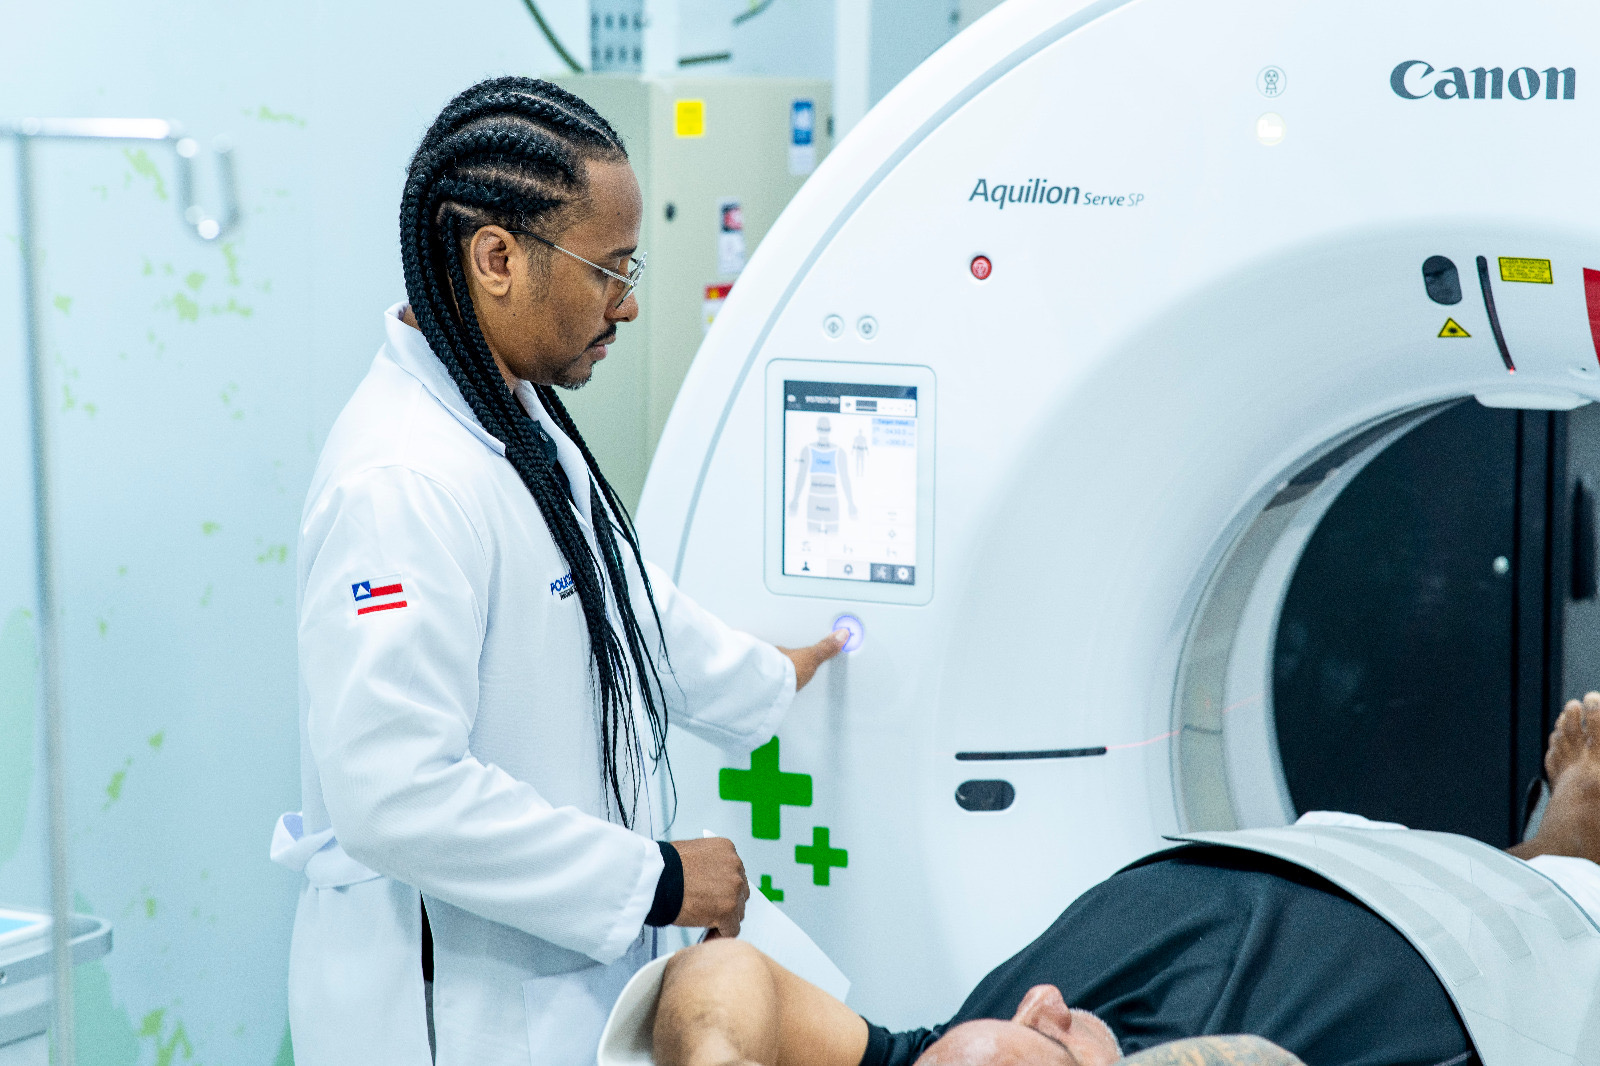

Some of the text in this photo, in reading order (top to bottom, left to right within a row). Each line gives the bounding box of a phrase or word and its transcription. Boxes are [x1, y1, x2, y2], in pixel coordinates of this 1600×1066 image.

[1390, 60, 1576, 100] Canon
[968, 178, 1144, 210] Aquilion Serve SP
